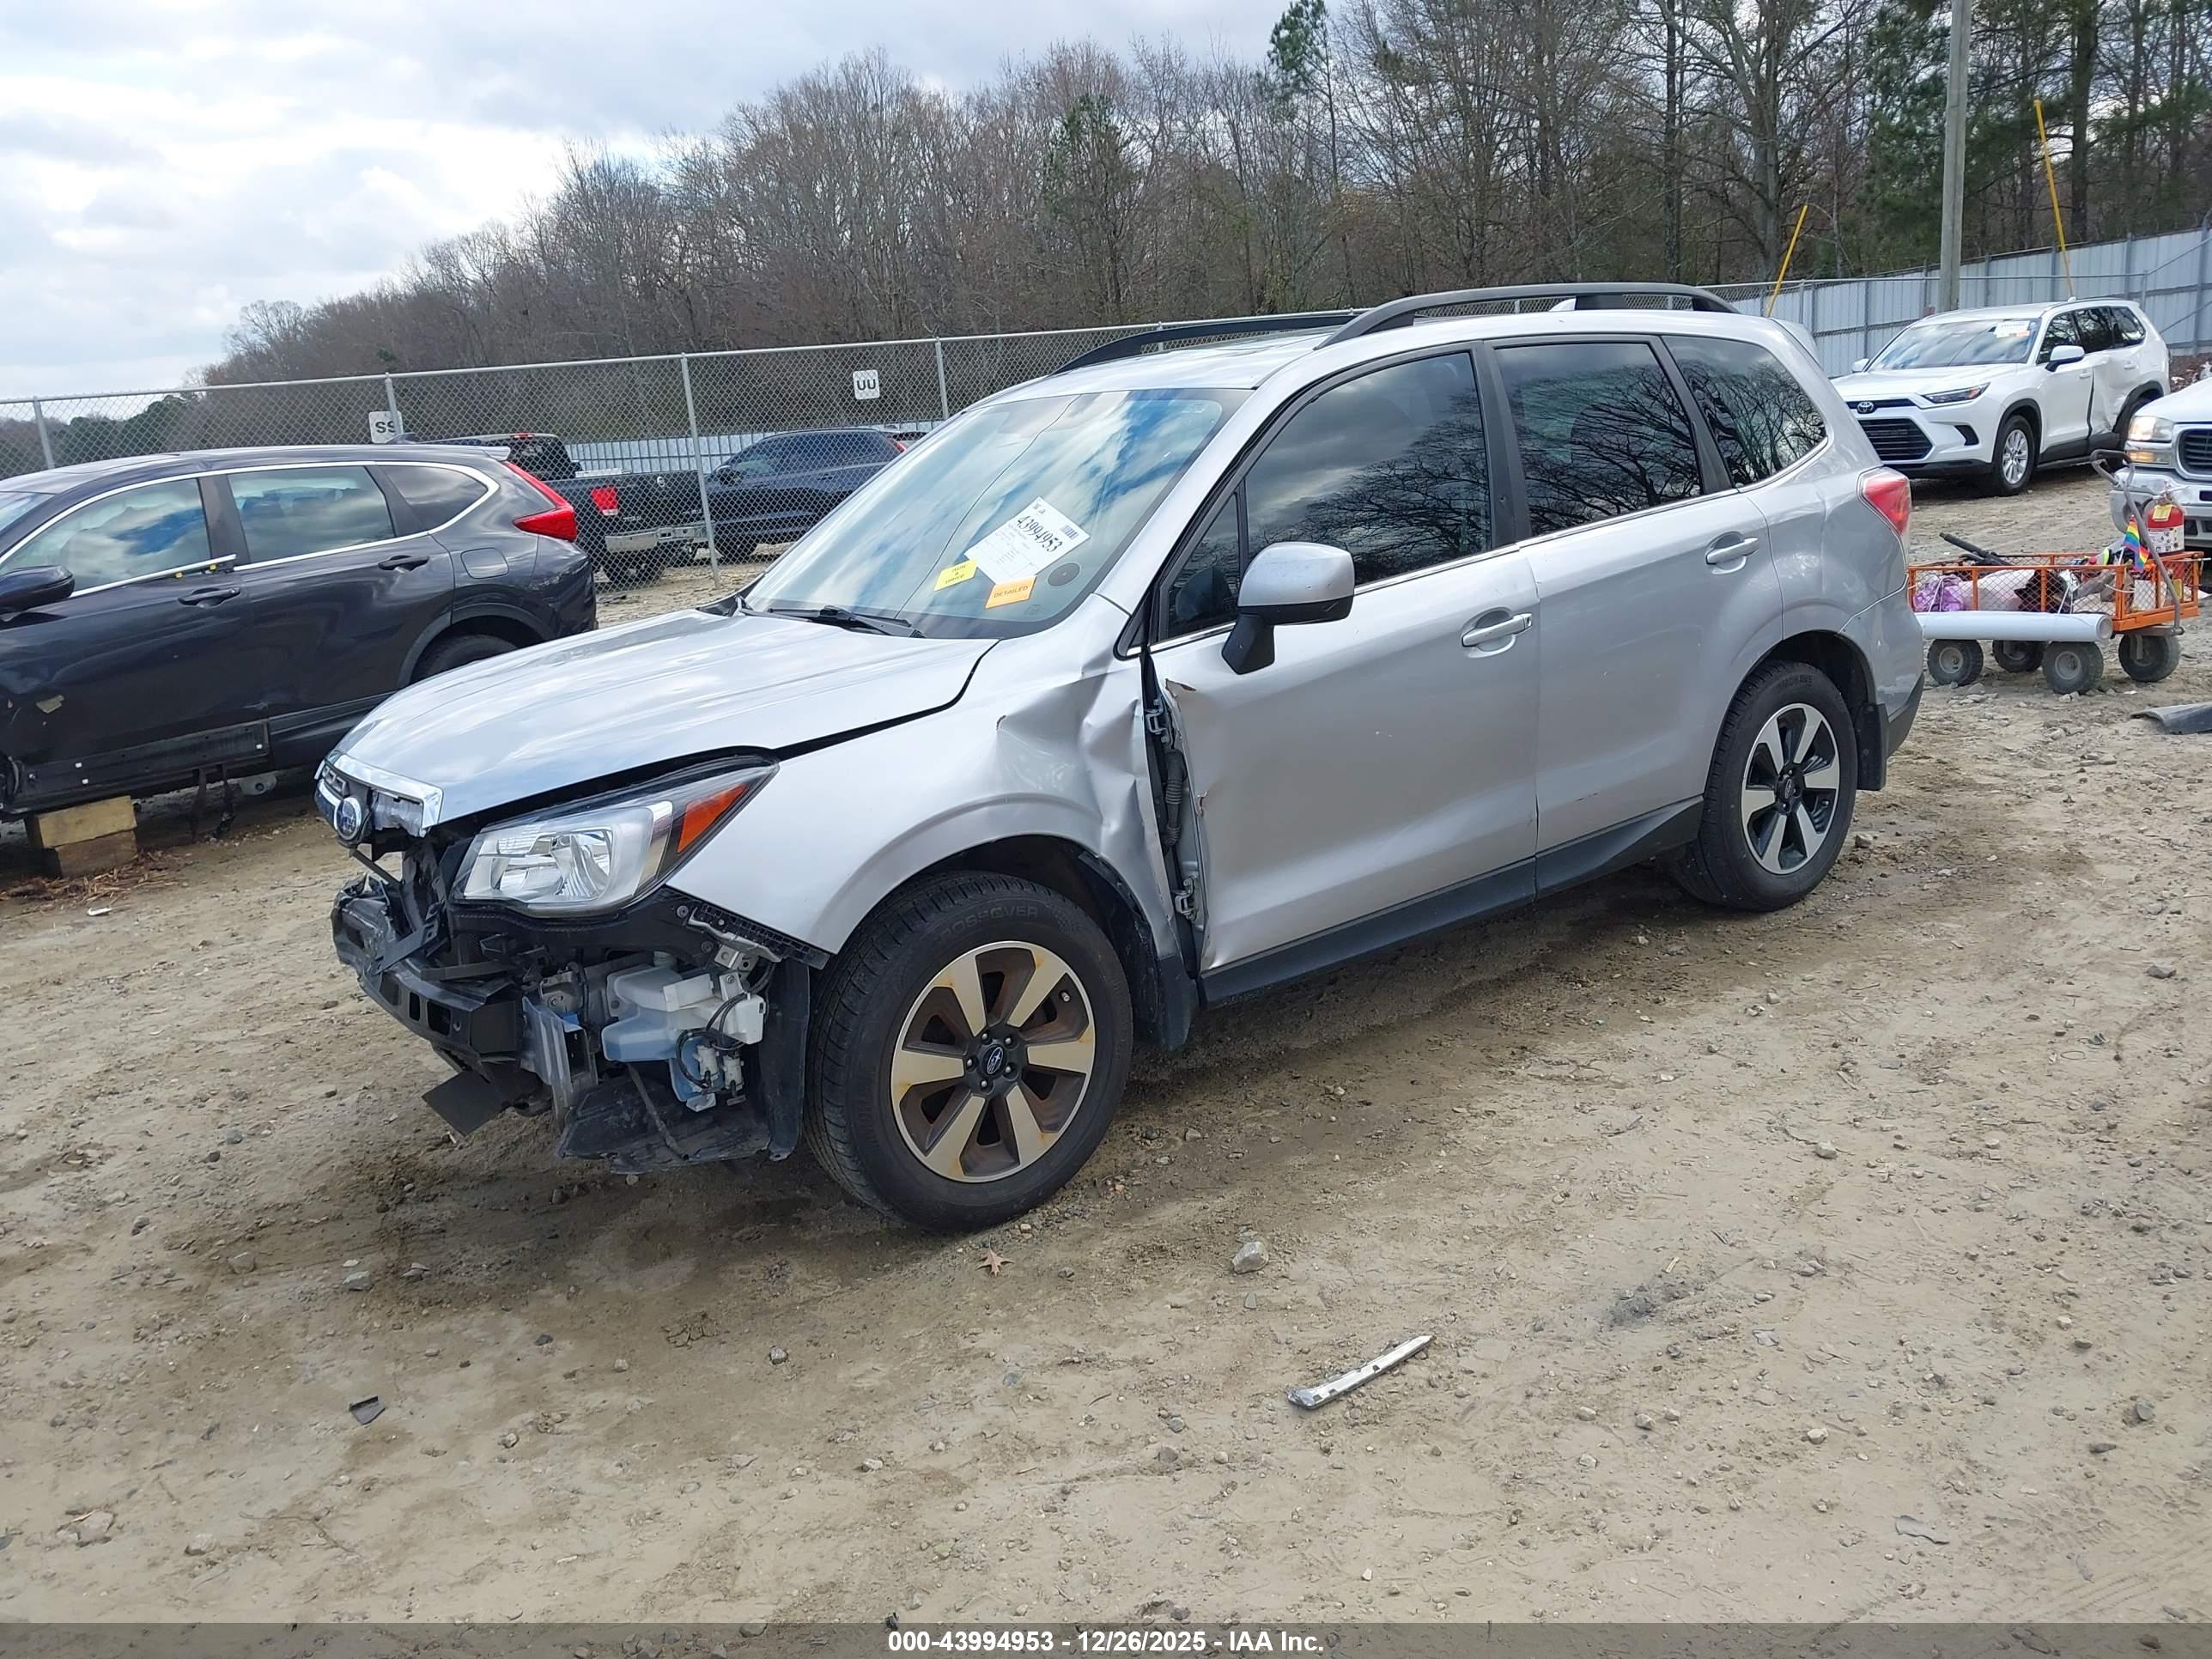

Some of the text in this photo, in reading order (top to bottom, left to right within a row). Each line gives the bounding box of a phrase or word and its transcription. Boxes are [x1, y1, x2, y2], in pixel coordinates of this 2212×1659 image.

[857, 379, 876, 391] UU
[1017, 515, 1063, 552] 43994953
[994, 585, 1029, 599] DETAILED
